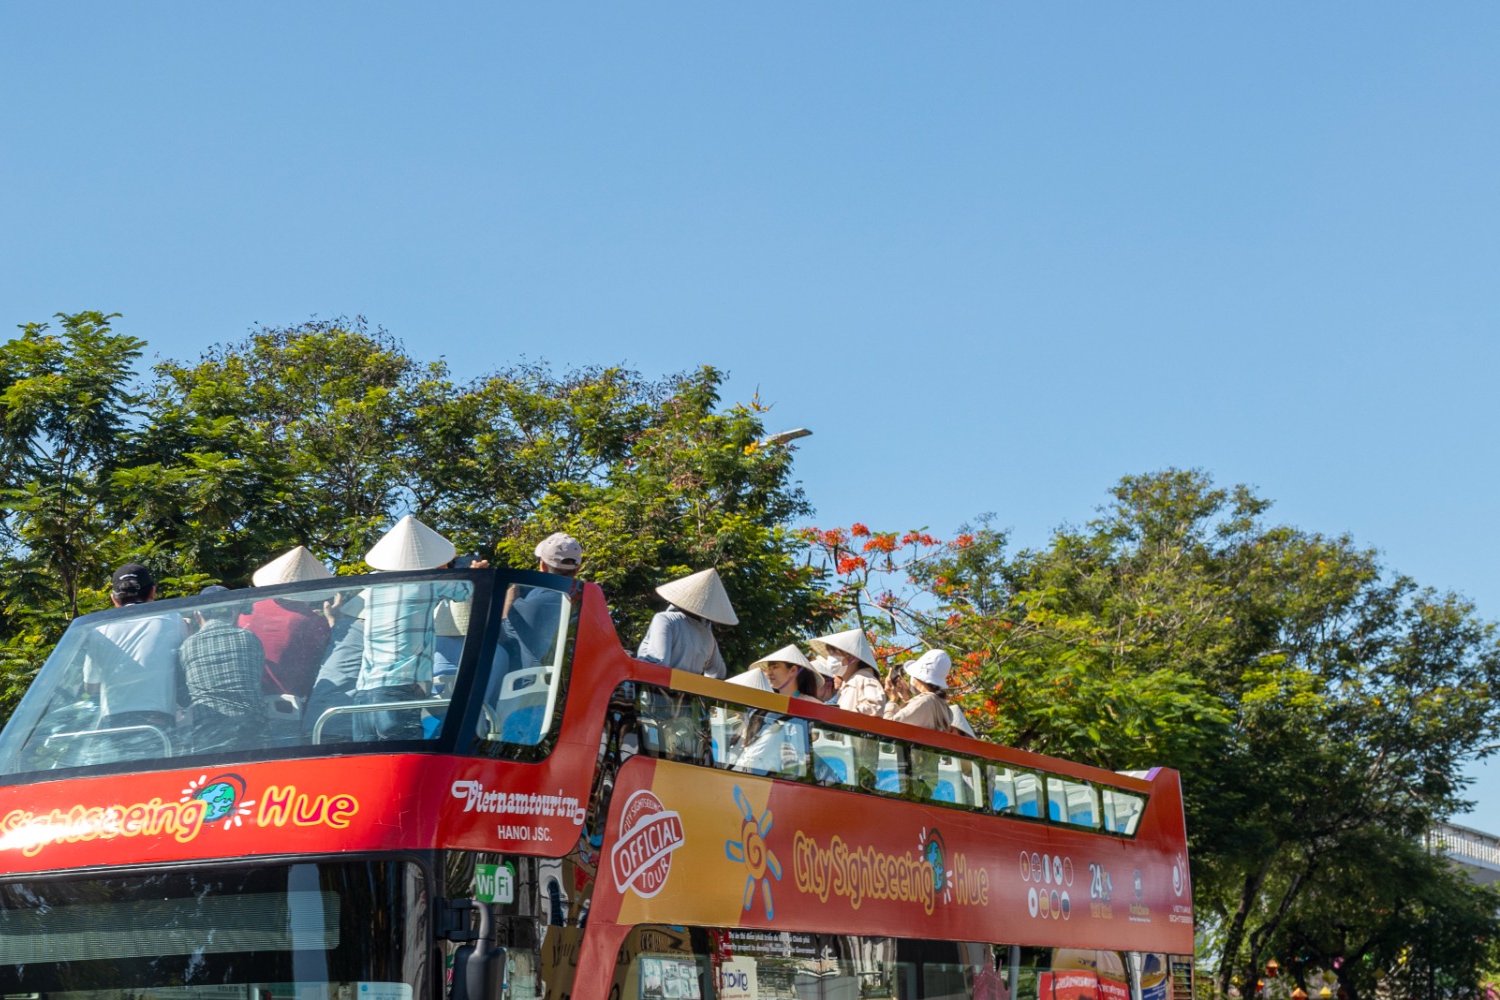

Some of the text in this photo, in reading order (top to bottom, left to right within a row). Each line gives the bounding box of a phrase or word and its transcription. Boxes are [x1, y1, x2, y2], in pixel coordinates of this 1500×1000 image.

[257, 785, 360, 829] Hue
[451, 780, 586, 825] Vietnamtourism
[497, 825, 553, 842] HANOI JSC.
[619, 818, 680, 878] OFFICIAL
[642, 857, 669, 889] TOUR
[953, 852, 989, 906] Hue
